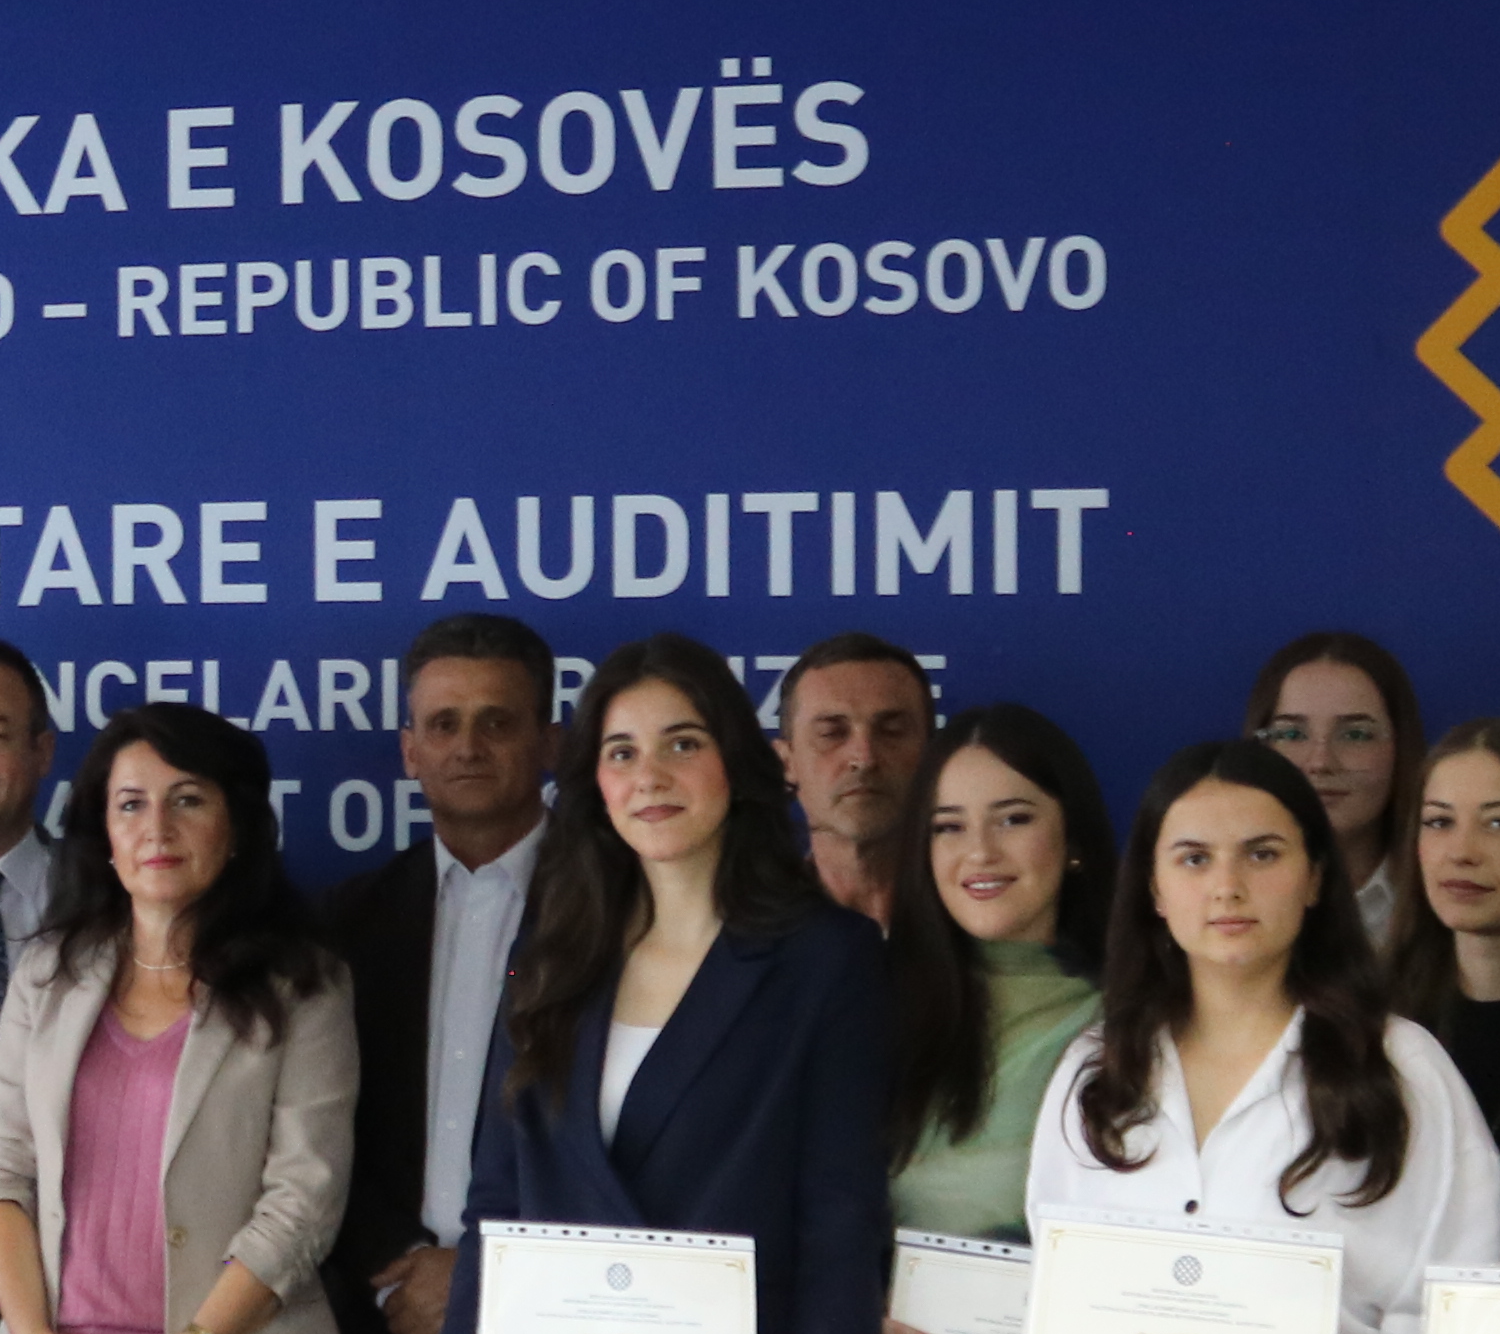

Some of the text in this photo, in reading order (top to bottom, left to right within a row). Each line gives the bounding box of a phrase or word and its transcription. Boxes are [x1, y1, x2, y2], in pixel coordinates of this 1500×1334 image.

[166, 105, 236, 210] E
[280, 56, 869, 205] KOSOVËS
[116, 251, 563, 339] REPUBLIC
[589, 247, 707, 324] OF
[737, 235, 1107, 318] KOSOVO
[313, 497, 383, 603] E
[419, 487, 1110, 602] AUDITIMIT
